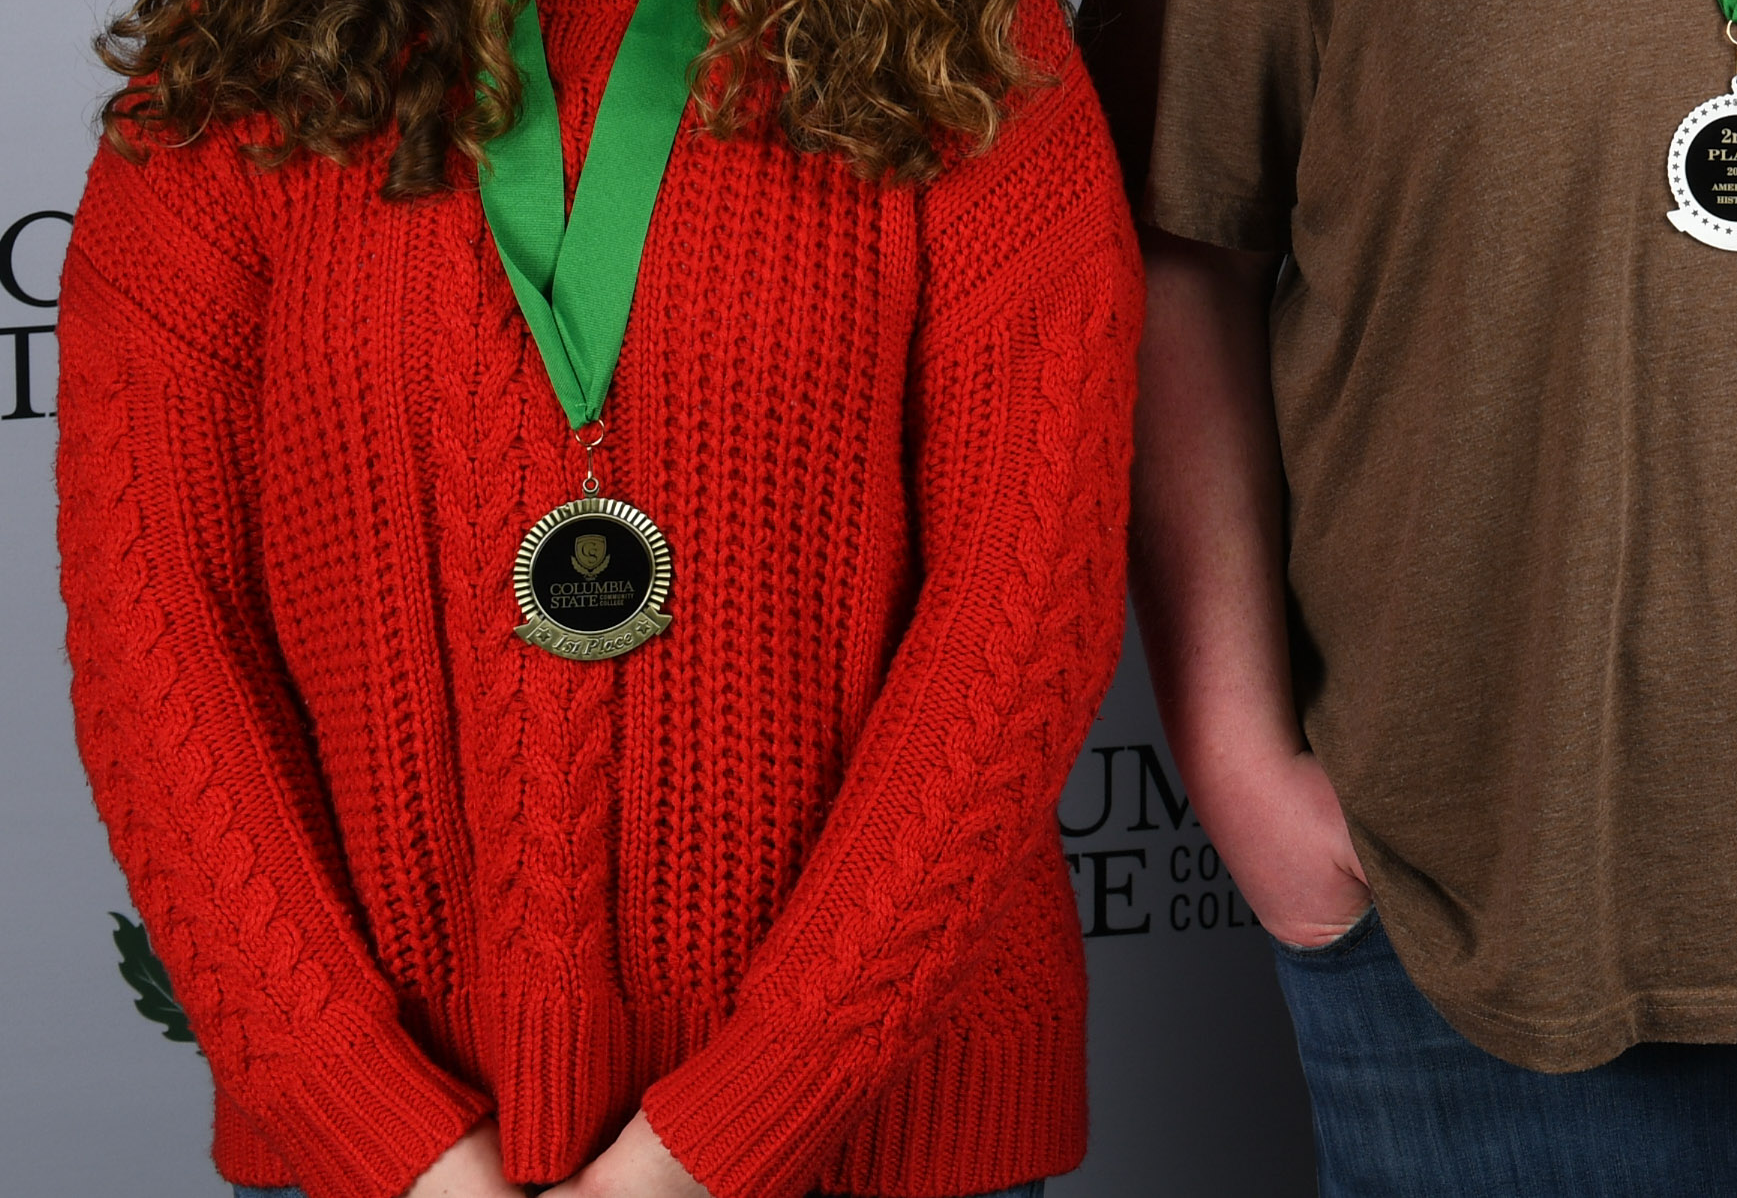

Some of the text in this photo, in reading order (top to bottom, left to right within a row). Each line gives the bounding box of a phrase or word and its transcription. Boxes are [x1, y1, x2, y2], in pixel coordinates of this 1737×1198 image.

[549, 580, 635, 597] COLUMBIA
[549, 594, 599, 610] STATE
[583, 631, 635, 657] Place
